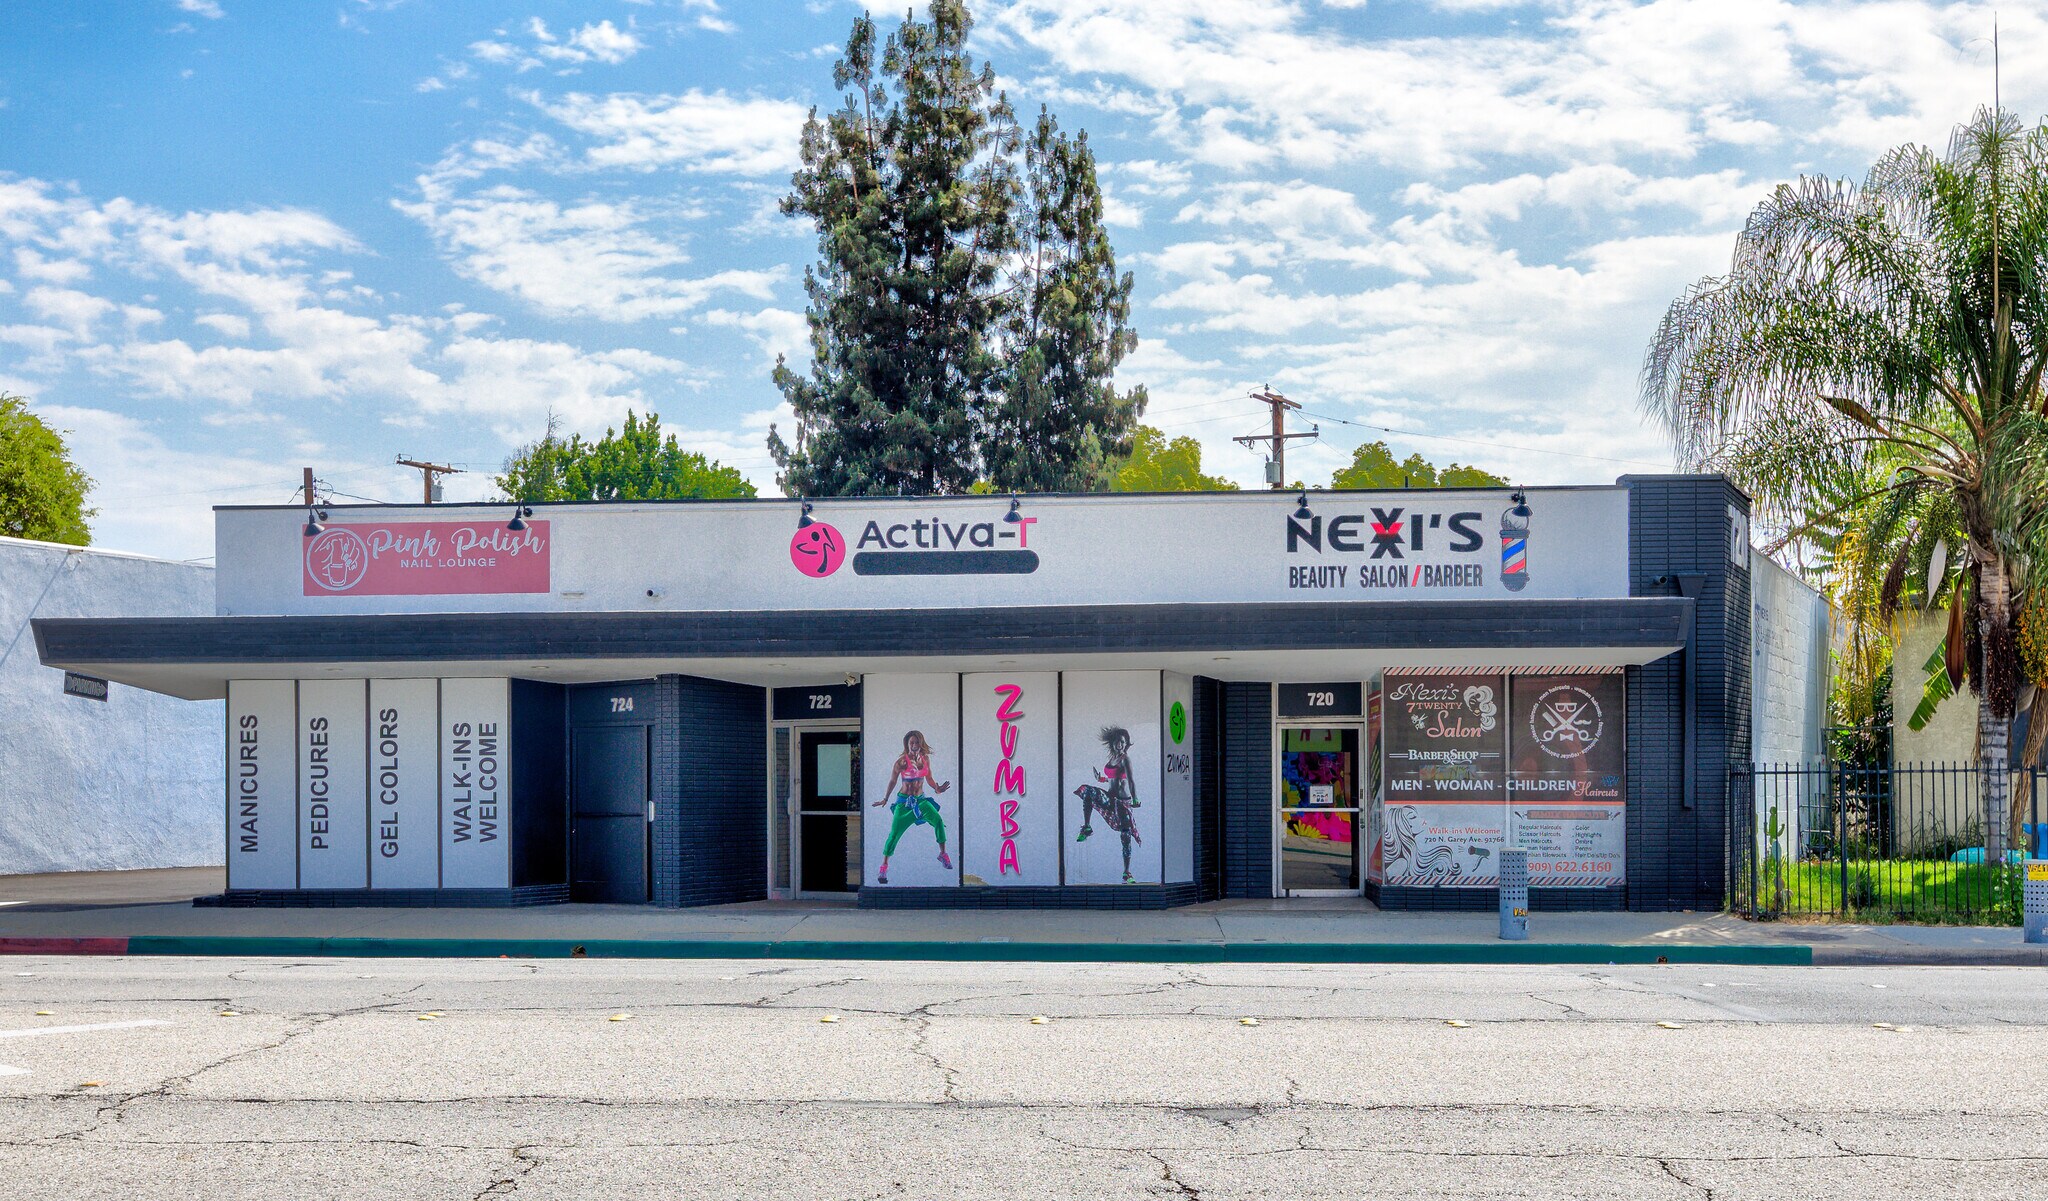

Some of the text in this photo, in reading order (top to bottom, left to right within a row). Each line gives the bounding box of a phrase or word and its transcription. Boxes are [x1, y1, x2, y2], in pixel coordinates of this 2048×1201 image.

[367, 527, 545, 559] Pink Polish
[856, 516, 1038, 550] Activa-T
[400, 557, 496, 568] NAIL LOUNGE
[1289, 565, 1347, 588] BEAUTY
[809, 695, 832, 709] 722
[1307, 692, 1334, 706] 720
[1389, 683, 1459, 700] Nexi's
[611, 697, 634, 712] 724
[1427, 710, 1481, 738] Salon
[1167, 754, 1190, 774] ZUMBA
[241, 714, 259, 853] MANICURES
[311, 716, 329, 849] PEDICURES
[381, 707, 398, 859] GEL COLORS
[453, 721, 472, 843] WALK-INS
[479, 722, 497, 843] WELCOME
[993, 684, 1026, 875] ZUMBA
[1391, 779, 1423, 791] MEN
[1434, 779, 1494, 791] WOMAN
[1506, 779, 1577, 791] CHILDREN
[1574, 781, 1619, 797] Haircuts
[1555, 861, 1612, 873] 622.6160
